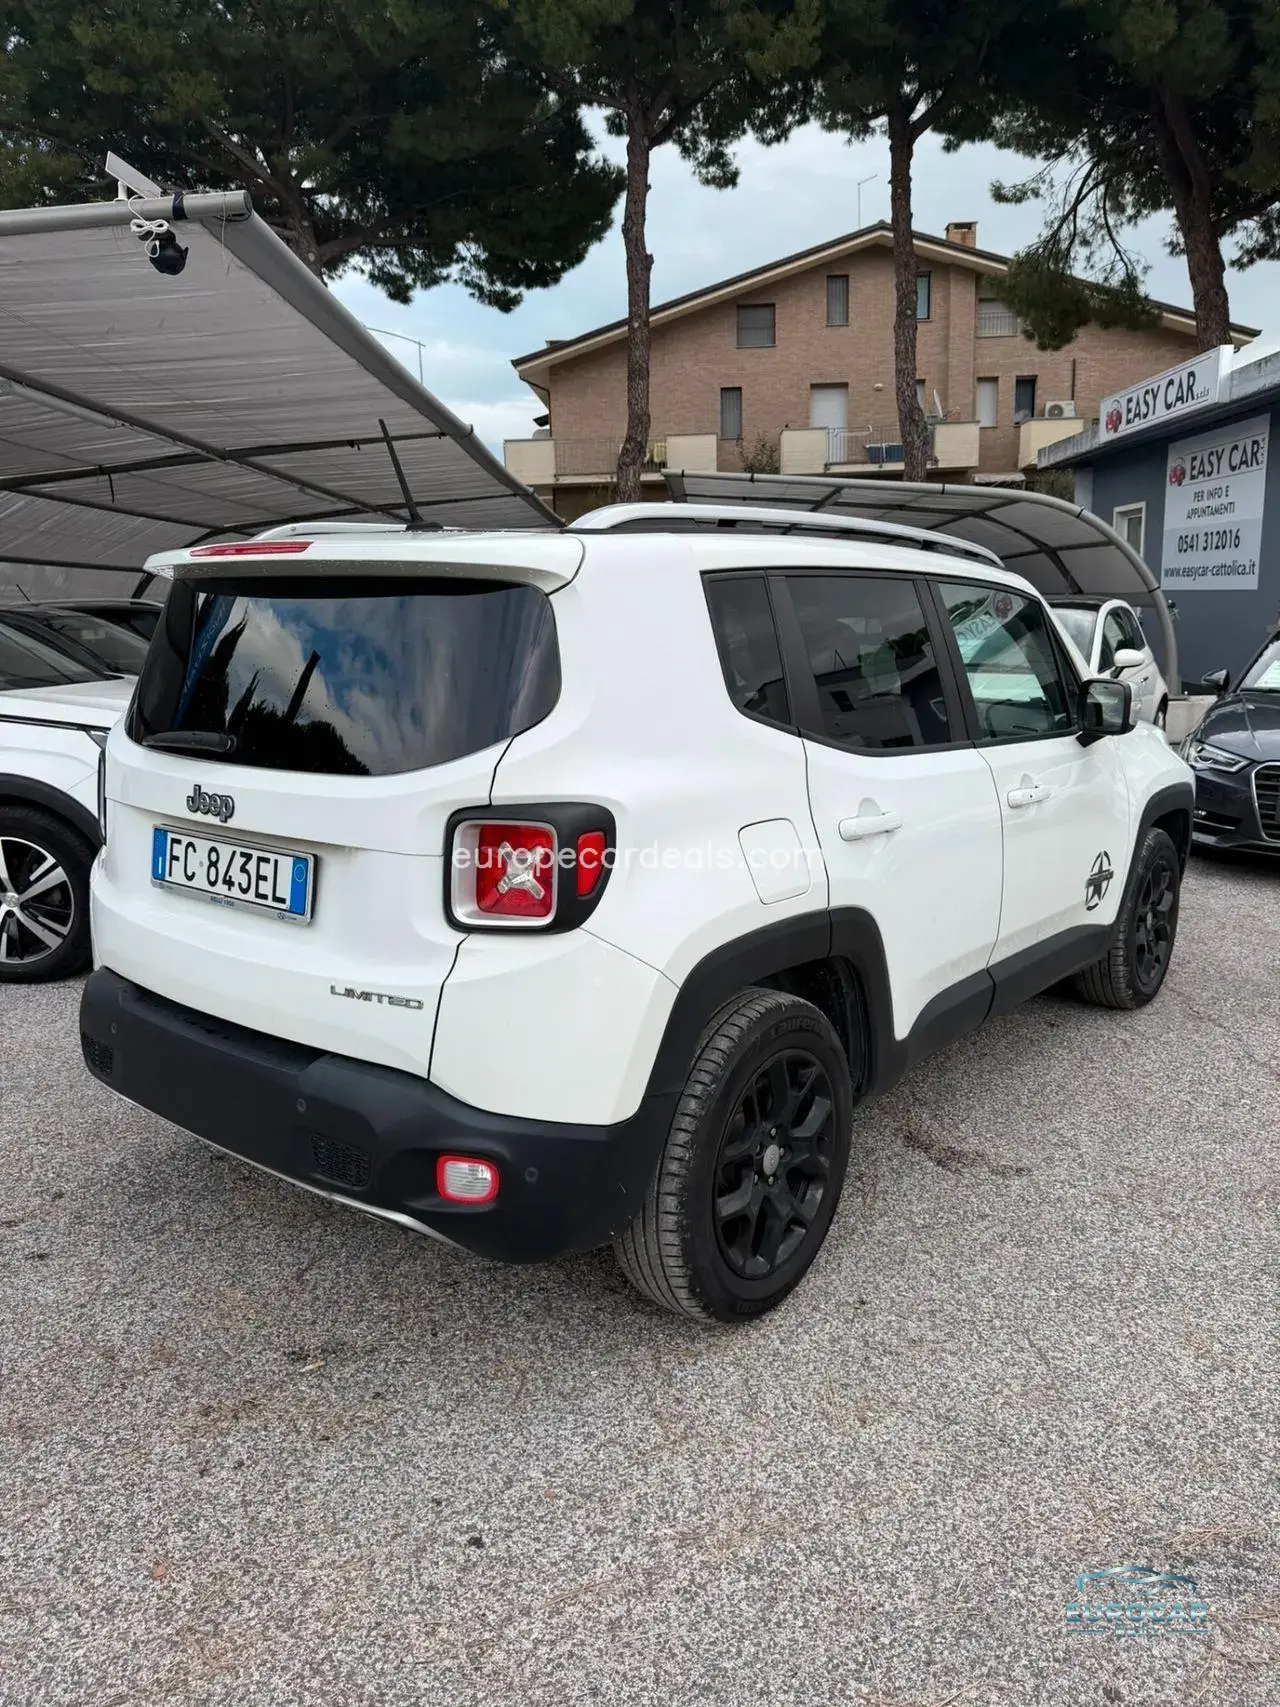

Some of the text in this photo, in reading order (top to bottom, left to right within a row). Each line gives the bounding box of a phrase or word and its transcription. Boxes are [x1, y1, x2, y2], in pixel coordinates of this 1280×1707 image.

[1126, 385, 1161, 426] EASY
[1164, 370, 1196, 411] CAR
[1190, 447, 1225, 481] EASY
[1229, 439, 1260, 469] CAR
[1193, 485, 1230, 503] PER INFO E
[1186, 501, 1235, 520] APPUNTAMENTI
[1178, 528, 1241, 554] 0541 312016
[1164, 559, 1256, 581] www.easycar-cattolica.it
[186, 784, 235, 823] Jeep
[168, 837, 287, 906] FC 843EL
[330, 984, 425, 1010] LIMITED
